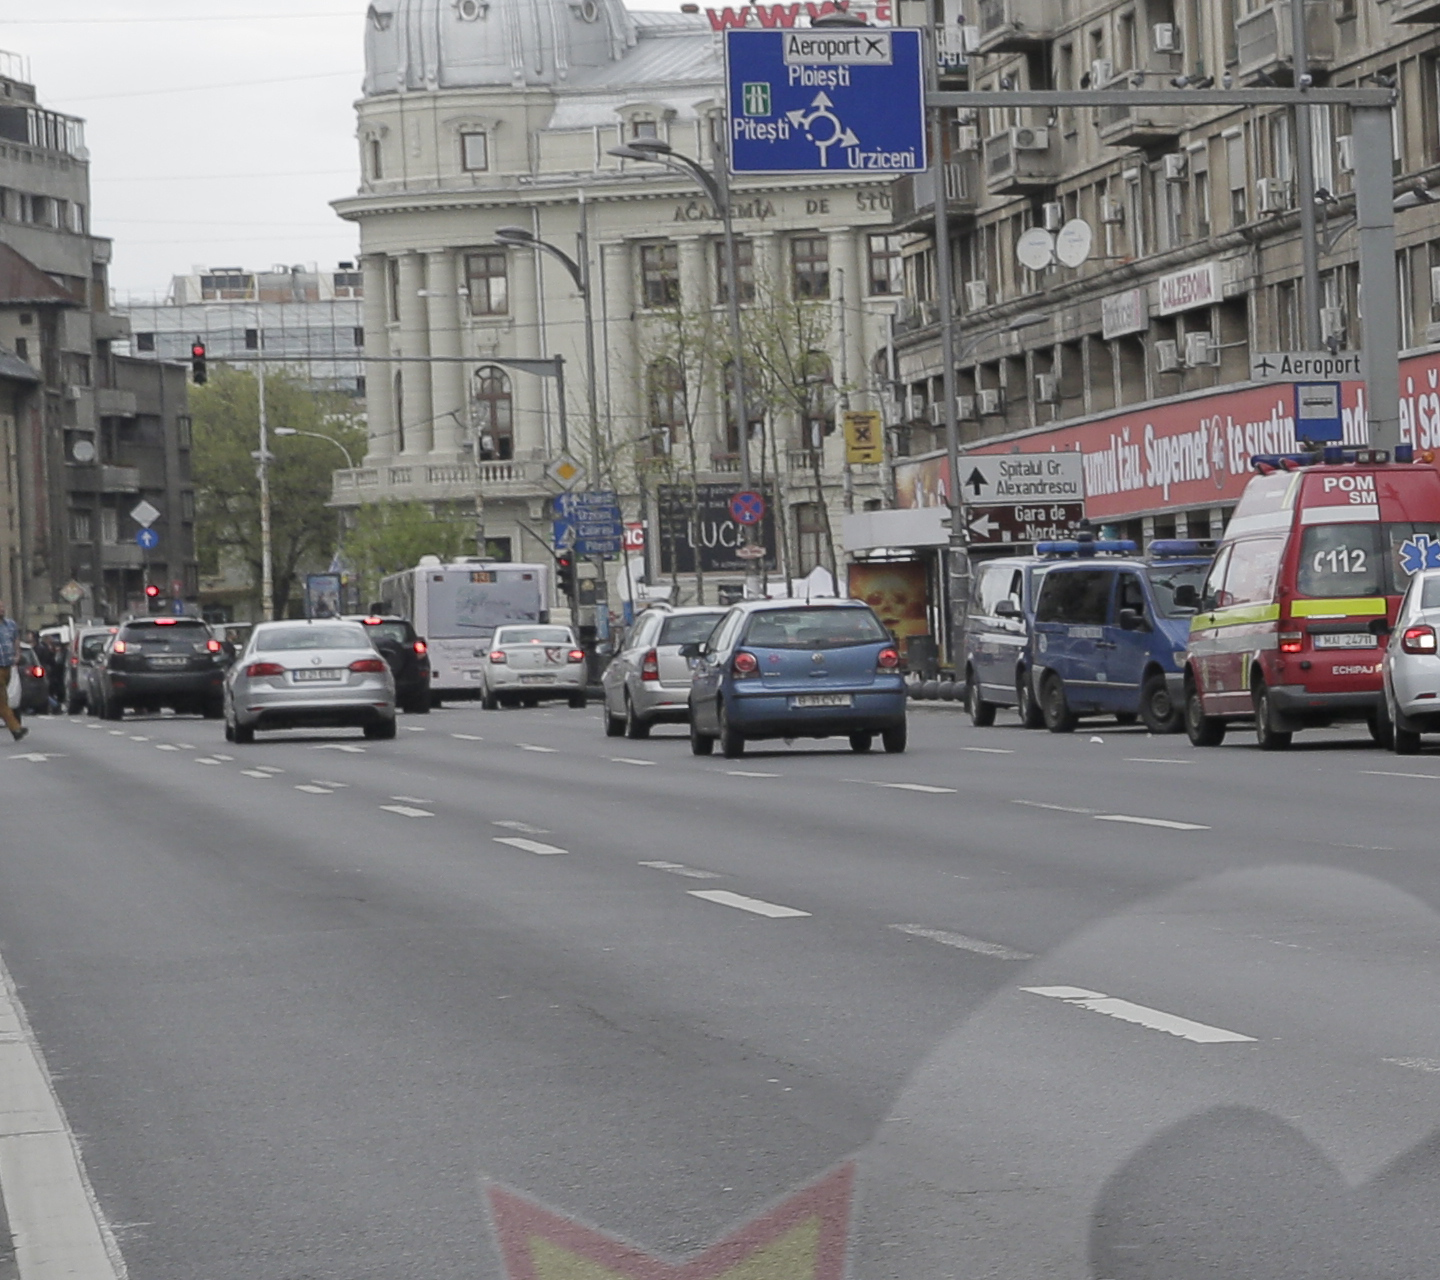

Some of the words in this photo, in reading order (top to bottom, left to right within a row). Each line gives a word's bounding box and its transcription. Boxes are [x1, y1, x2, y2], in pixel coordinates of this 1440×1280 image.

[788, 35, 861, 61] Aeroport
[788, 65, 851, 90] Ploiești
[733, 118, 790, 143] Pitești
[847, 147, 916, 169] Urziceni
[673, 197, 777, 221] ACAEMIA
[806, 199, 830, 214] DE
[1280, 354, 1361, 375] Aeroport
[1227, 416, 1244, 475] te
[1000, 461, 1043, 479] Spitalul
[1047, 460, 1064, 476] Gr.
[996, 477, 1077, 495] Alexandrescu
[1323, 476, 1374, 493] POM
[1349, 491, 1377, 504] SM
[1014, 506, 1045, 521] Gara
[1050, 505, 1066, 520] de
[1026, 523, 1057, 540] Nord
[1326, 549, 1366, 572] 112
[1332, 664, 1375, 675] ECHIPAJ
